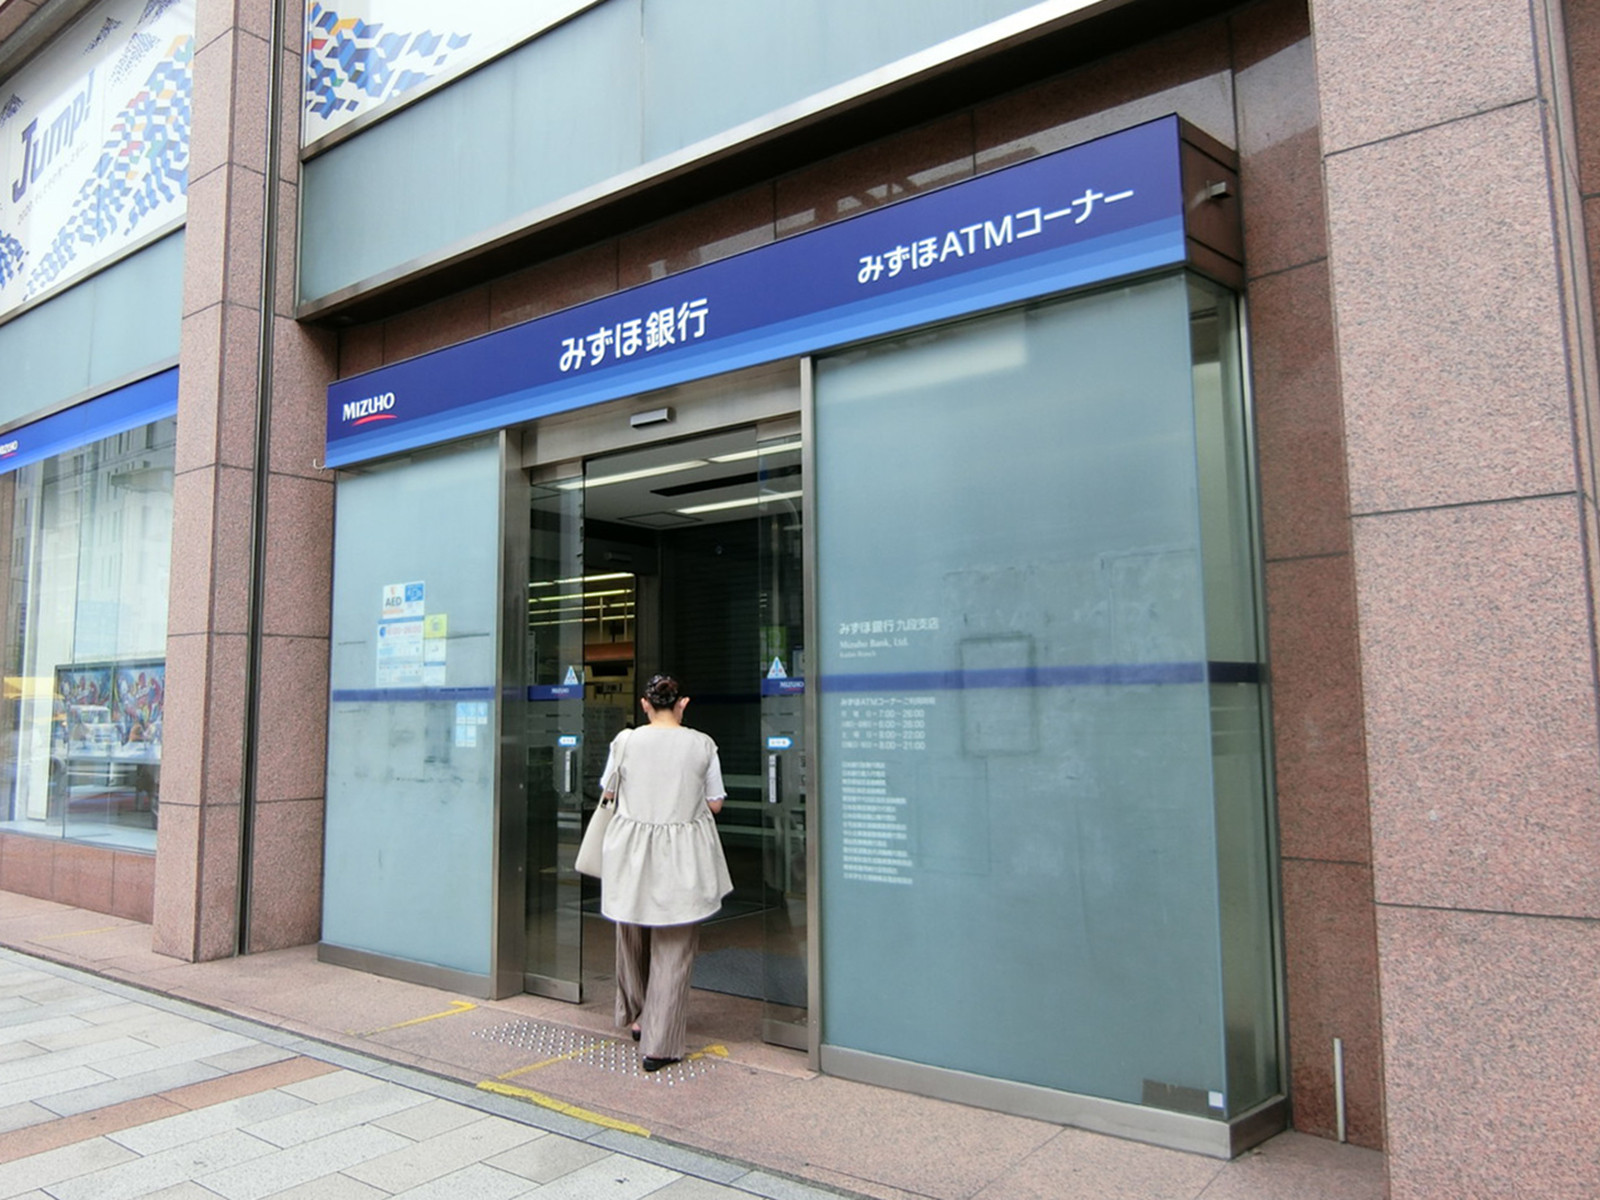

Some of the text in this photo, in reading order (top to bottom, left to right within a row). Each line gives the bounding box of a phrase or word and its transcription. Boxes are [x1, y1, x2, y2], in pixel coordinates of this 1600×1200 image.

[12, 68, 95, 203] Jump!
[857, 189, 1134, 284] みずほATMコーナー
[559, 298, 709, 372] みずほ銀行
[342, 391, 396, 421] MIZUHO
[385, 596, 402, 607] AED
